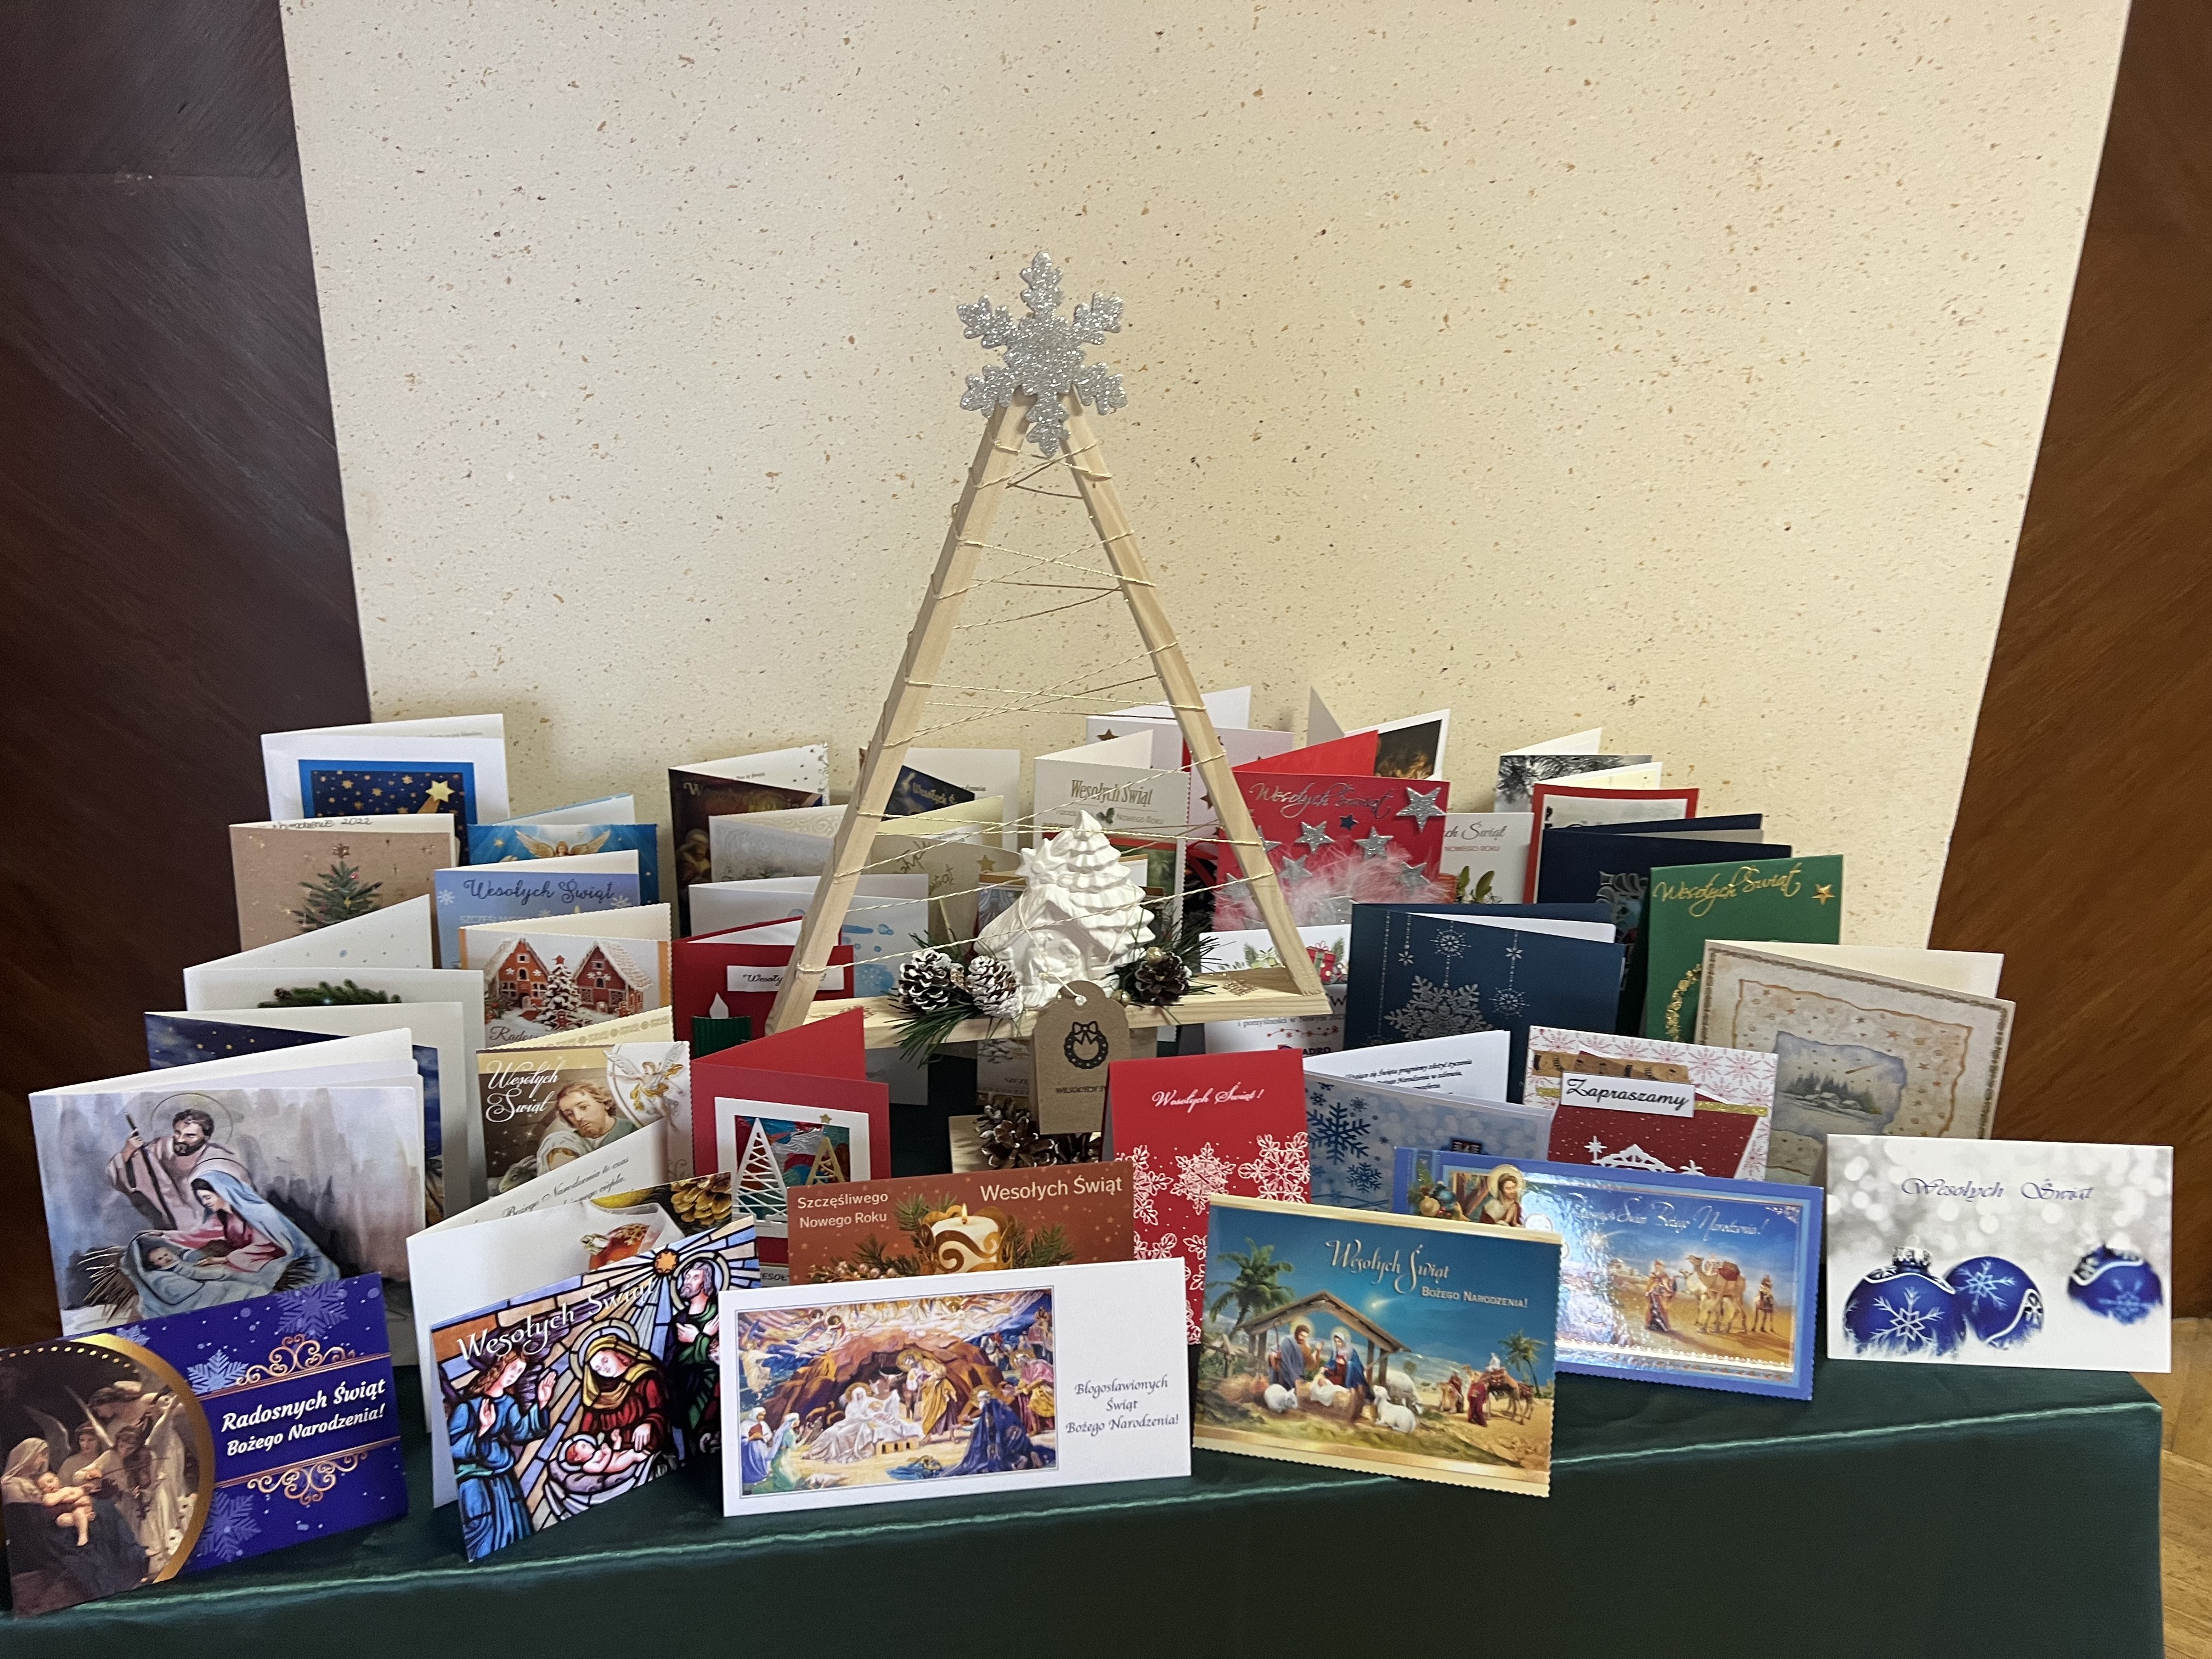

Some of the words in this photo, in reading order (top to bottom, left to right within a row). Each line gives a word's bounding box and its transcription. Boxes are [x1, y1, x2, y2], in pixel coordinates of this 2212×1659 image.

[1071, 780, 1120, 803] Wesołych
[463, 879, 555, 906] Wesołych
[558, 878, 615, 904] Świąt
[743, 974, 783, 986] Wesoły
[486, 1060, 568, 1098] Wesołych
[486, 1084, 555, 1123] Świąt
[1152, 1088, 1214, 1113] Wesołych
[1566, 1079, 1690, 1111] Zapraszamy
[980, 1180, 1068, 1201] Wesołych
[1073, 1175, 1122, 1195] Świąt
[1901, 1178, 2005, 1202] Wesołych
[797, 1193, 888, 1209] Szczęśliwego
[799, 1216, 852, 1228] Nowego
[855, 1211, 888, 1223] Roku
[1325, 1239, 1400, 1285] Wesołych
[1393, 1244, 1449, 1294] Świąt
[456, 1302, 575, 1361] Wesołych
[588, 1277, 657, 1316] Świąt
[1075, 1374, 1168, 1399] Błogosławionych
[221, 1390, 328, 1432] Radosnych
[333, 1379, 386, 1405] Świąt
[1105, 1397, 1138, 1412] Świąt
[227, 1432, 284, 1457] Bożego
[287, 1403, 386, 1441] Narodzenia!
[1065, 1421, 1105, 1437] Bożego
[1108, 1413, 1179, 1430] Narodzenia!
